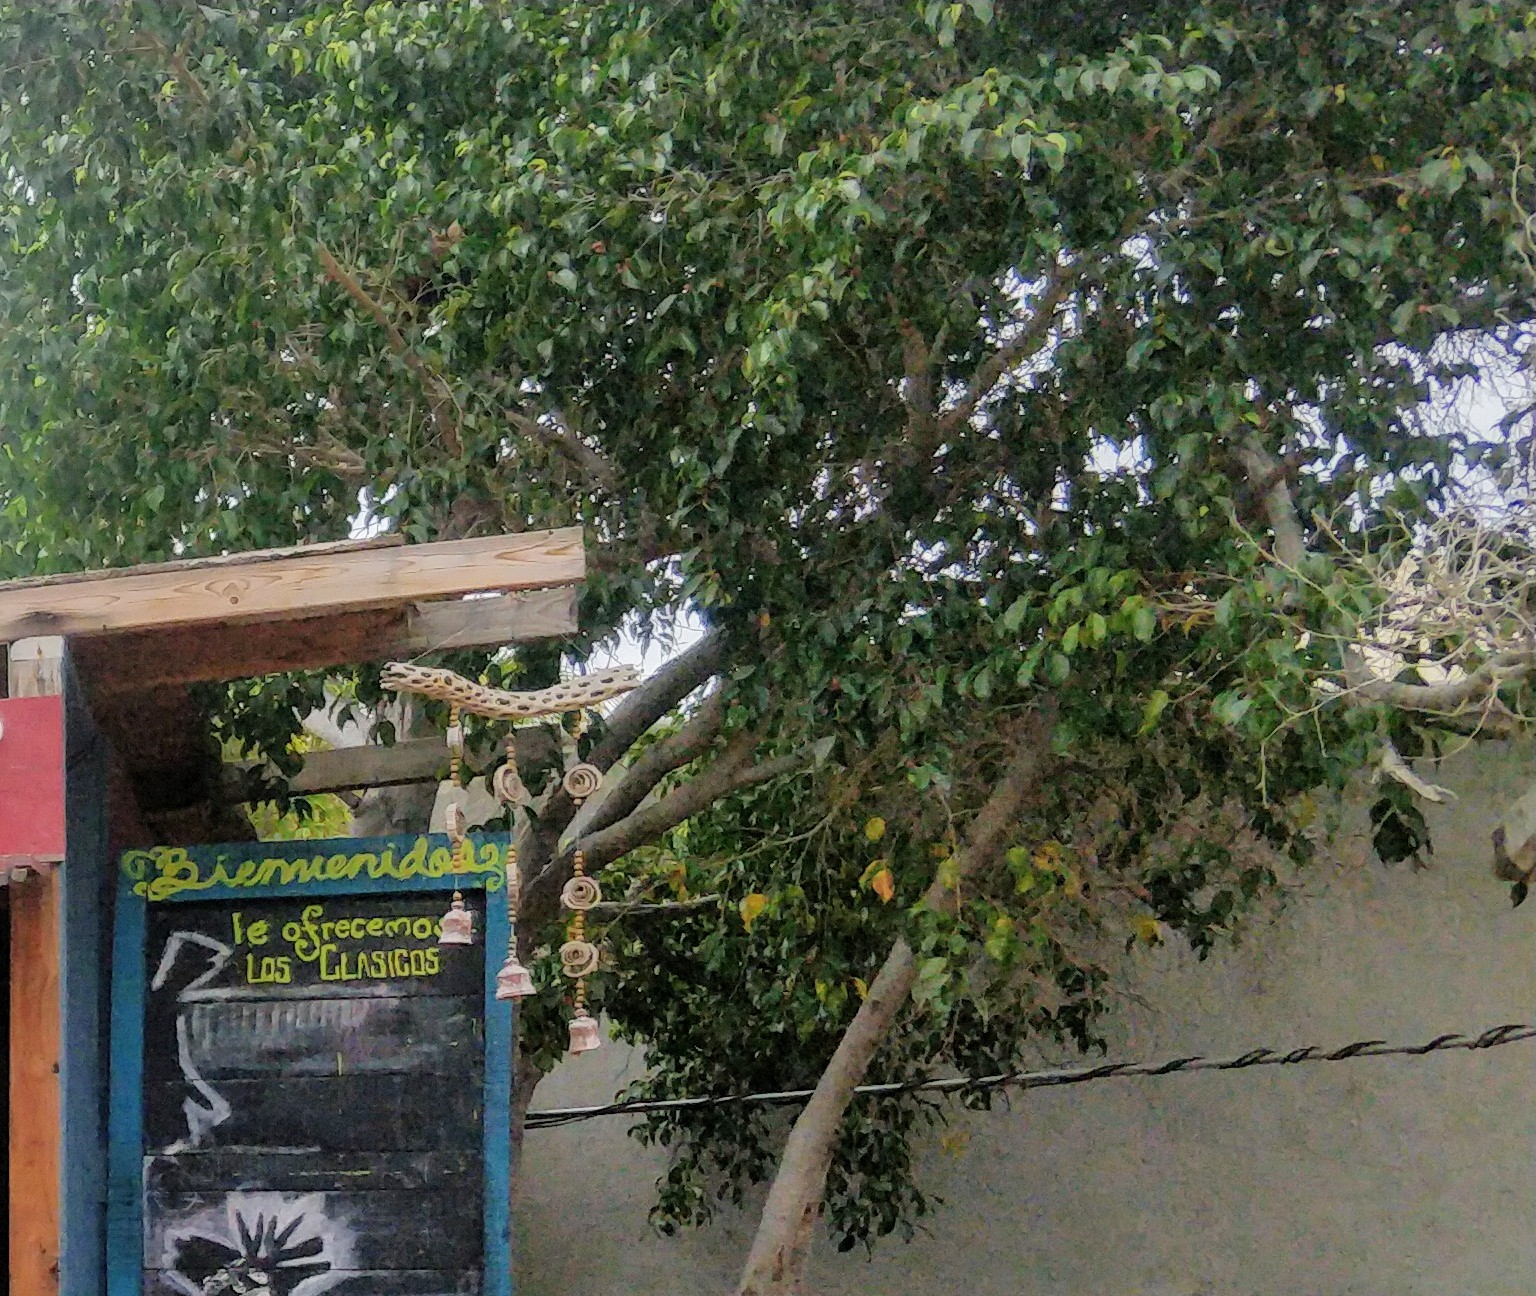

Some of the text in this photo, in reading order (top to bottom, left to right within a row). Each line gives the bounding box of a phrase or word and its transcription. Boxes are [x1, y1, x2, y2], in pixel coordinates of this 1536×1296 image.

[281, 904, 445, 962] ofrecemo
[246, 944, 441, 984] LOS CLASICOS
